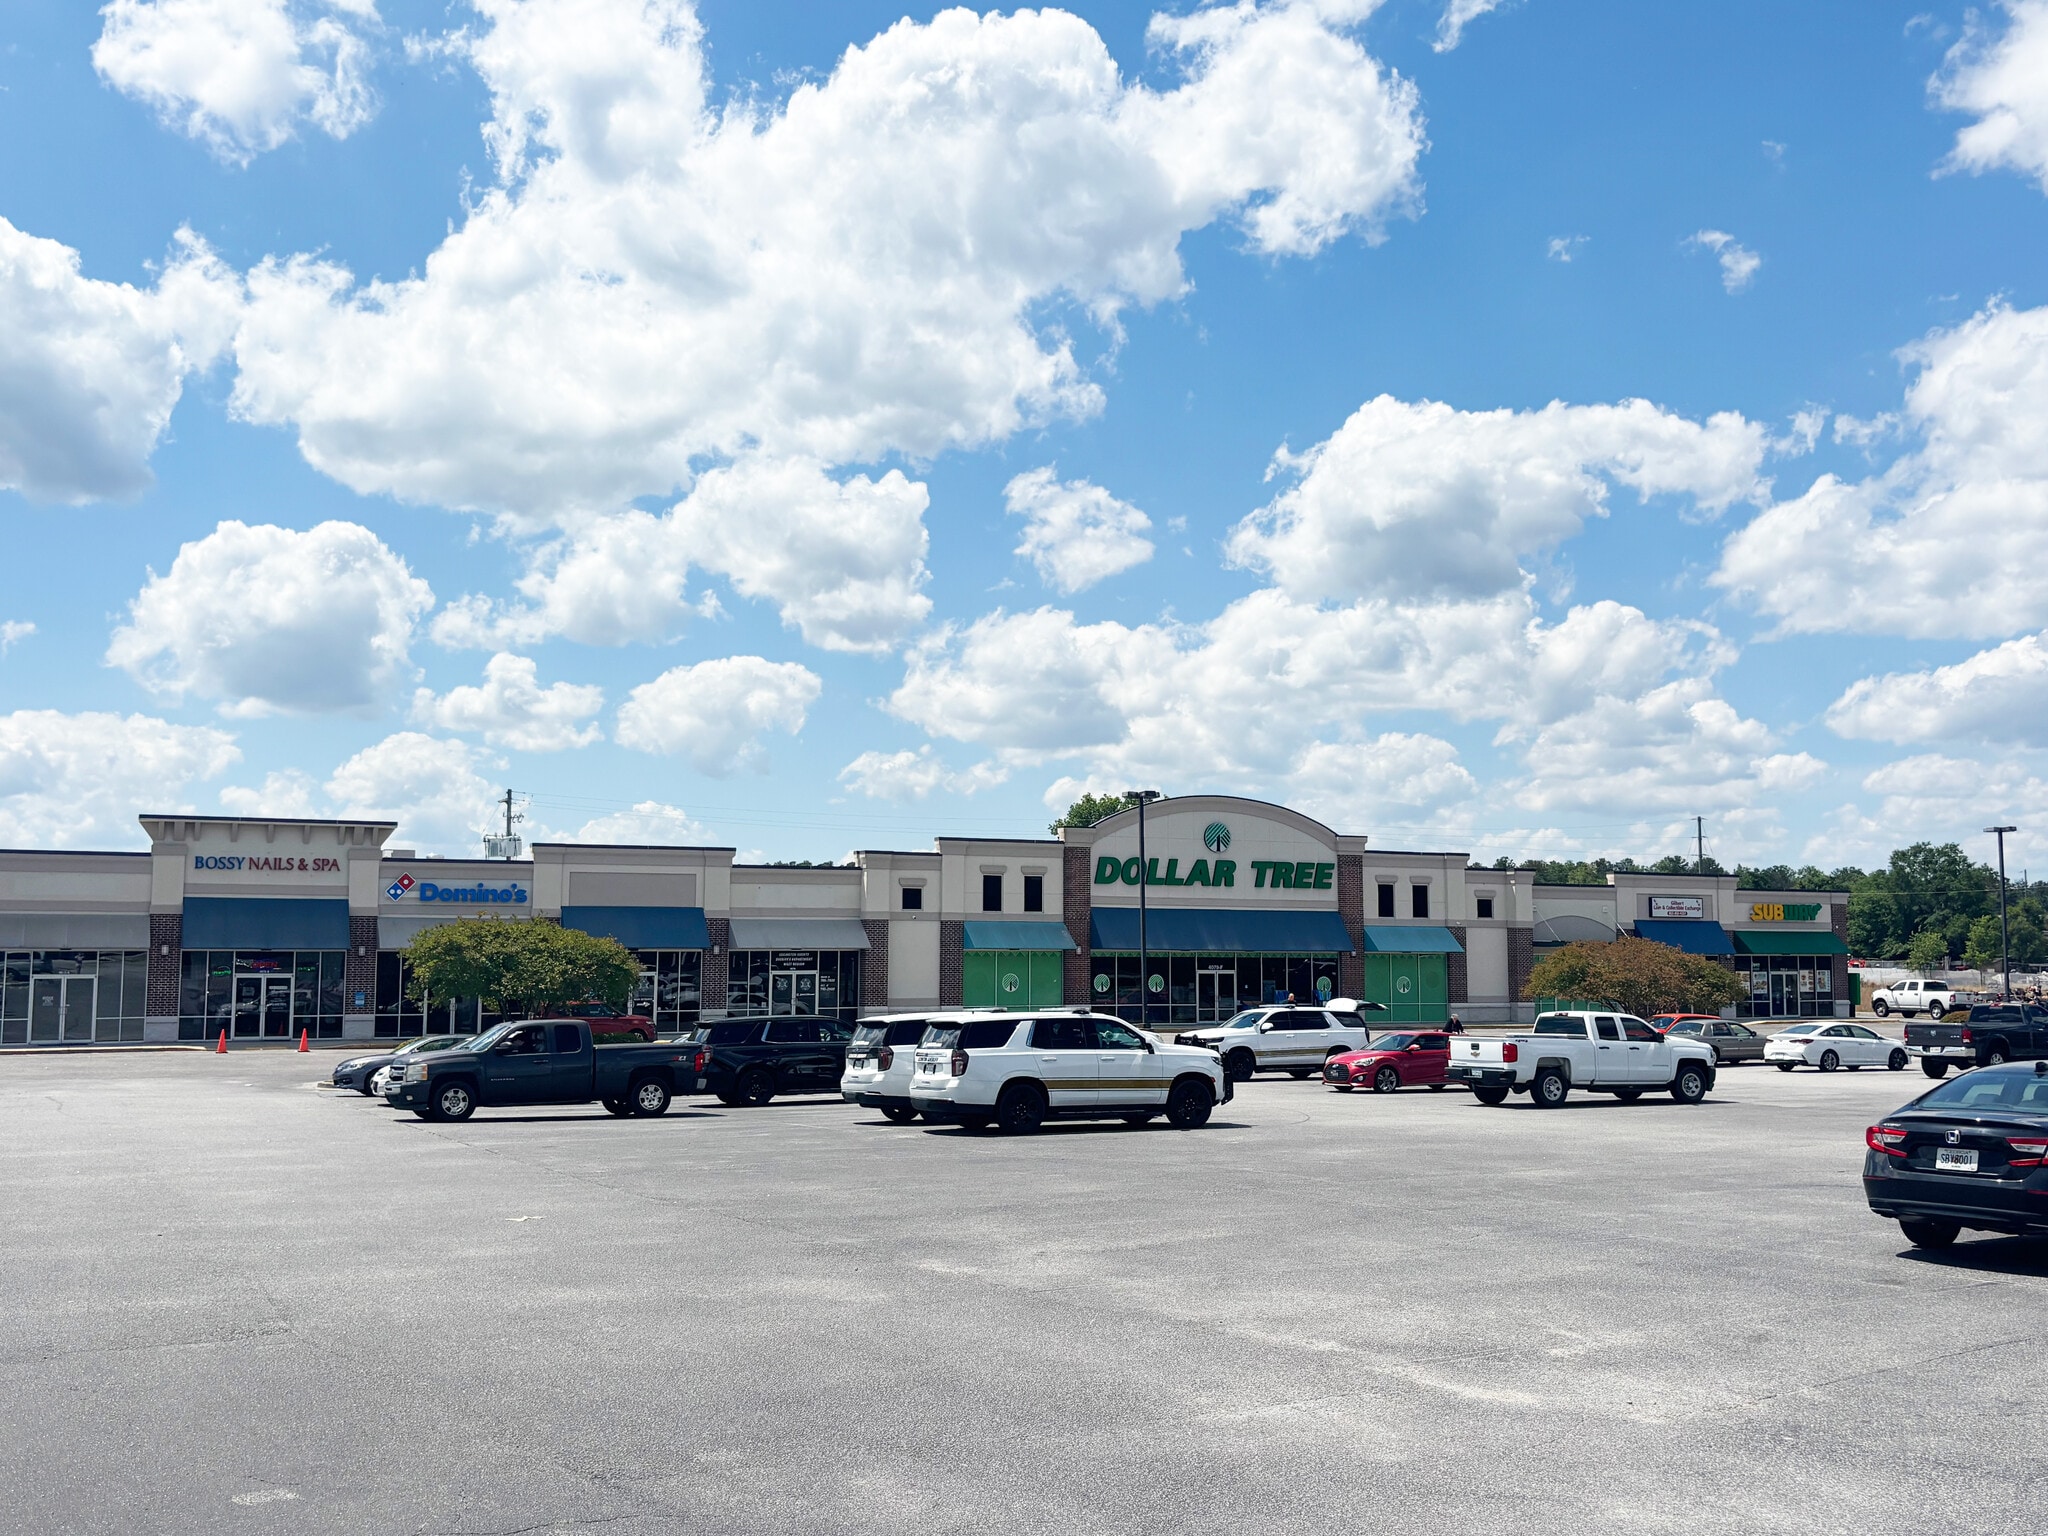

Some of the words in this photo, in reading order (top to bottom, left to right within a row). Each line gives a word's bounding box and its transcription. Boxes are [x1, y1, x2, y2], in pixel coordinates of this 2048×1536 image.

[194, 856, 246, 870] BOSSY
[248, 857, 294, 871] NAILS
[298, 857, 308, 871] &
[312, 858, 341, 872] SPA
[1094, 856, 1237, 887] DOLLAR
[1250, 860, 1336, 889] TREE
[419, 882, 528, 903] Domino's
[1750, 903, 1823, 922] SUBWAY
